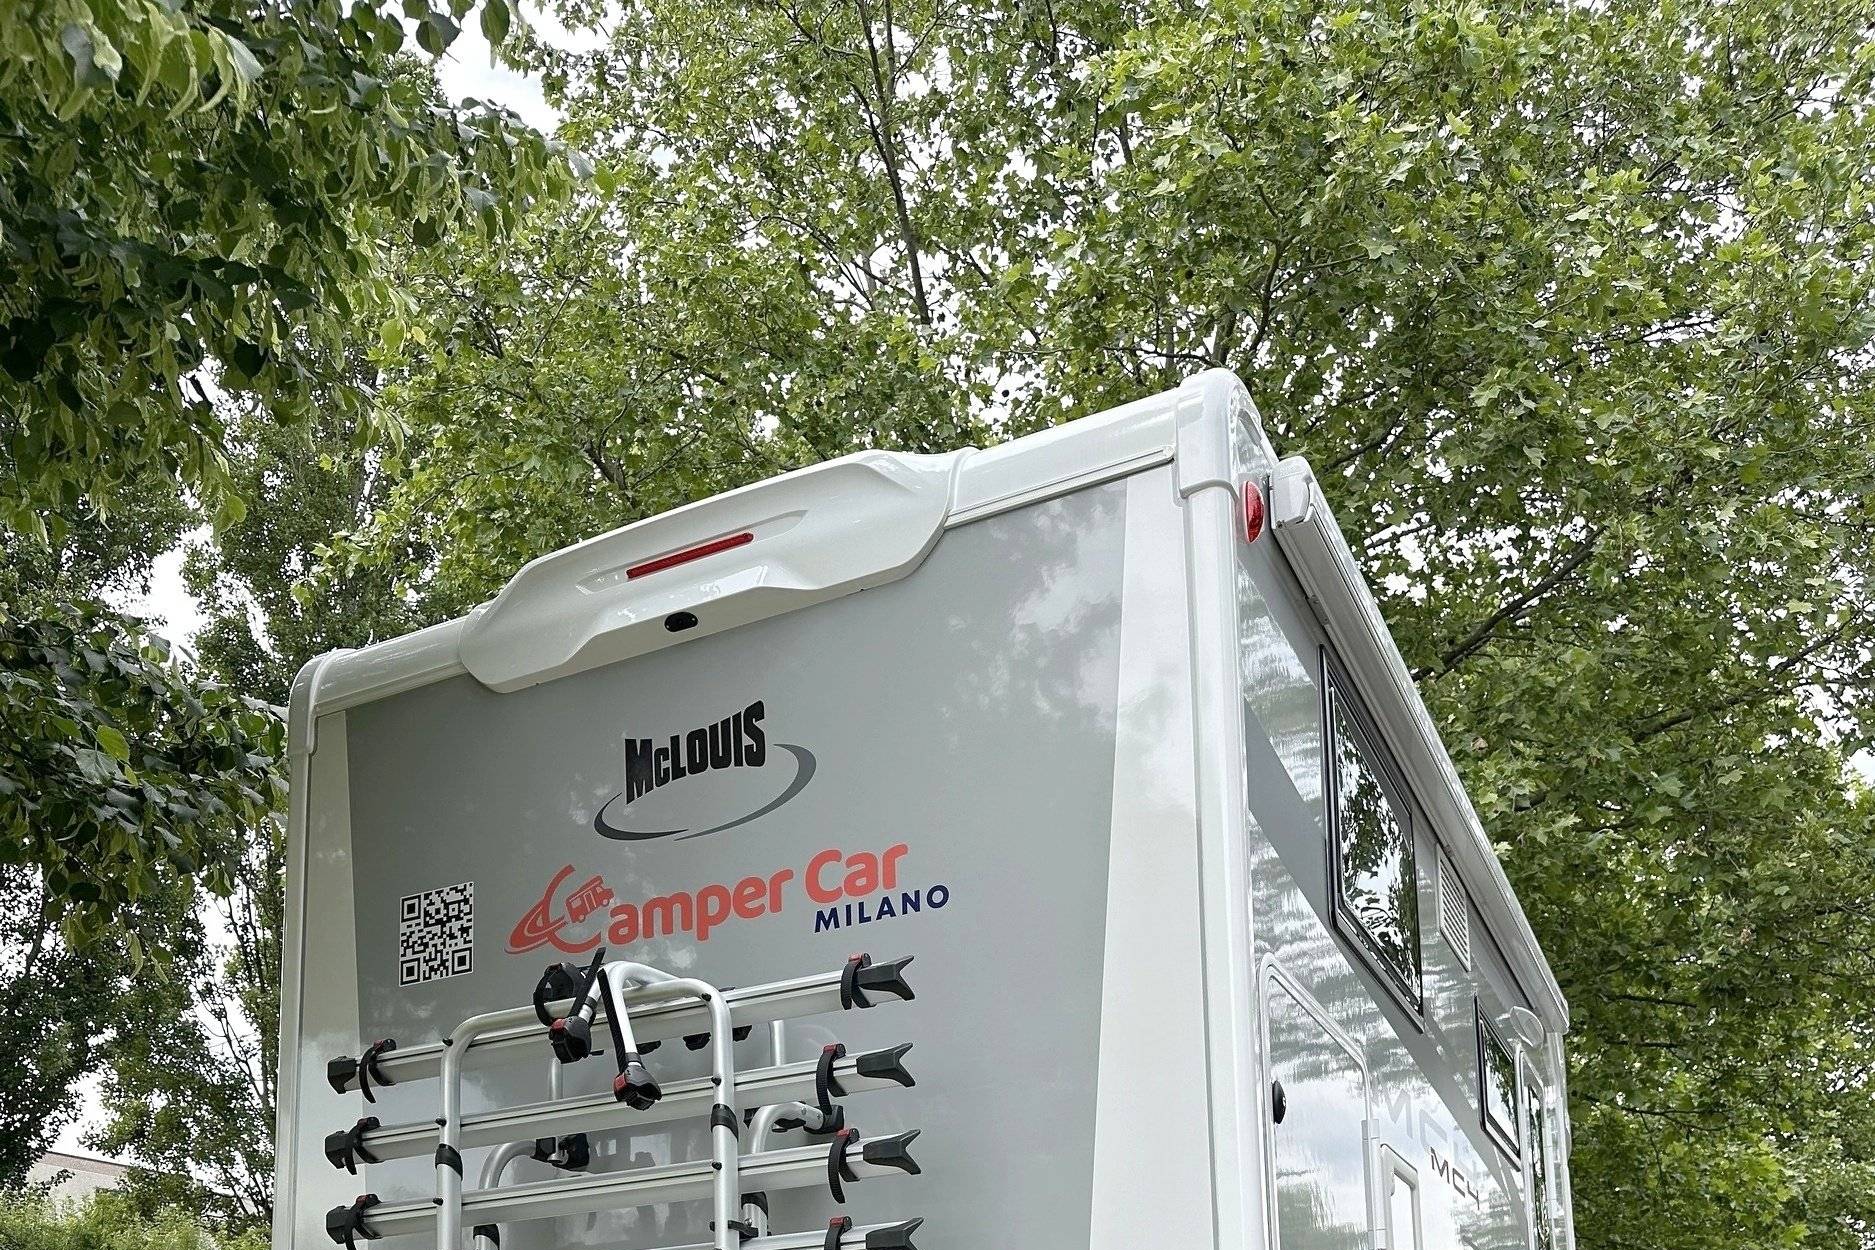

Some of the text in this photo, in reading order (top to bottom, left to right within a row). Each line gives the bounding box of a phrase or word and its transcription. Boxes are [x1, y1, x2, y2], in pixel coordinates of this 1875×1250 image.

[504, 842, 909, 955] Camper Car
[813, 884, 950, 933] MILANO
[1430, 1146, 1480, 1211] MC4
